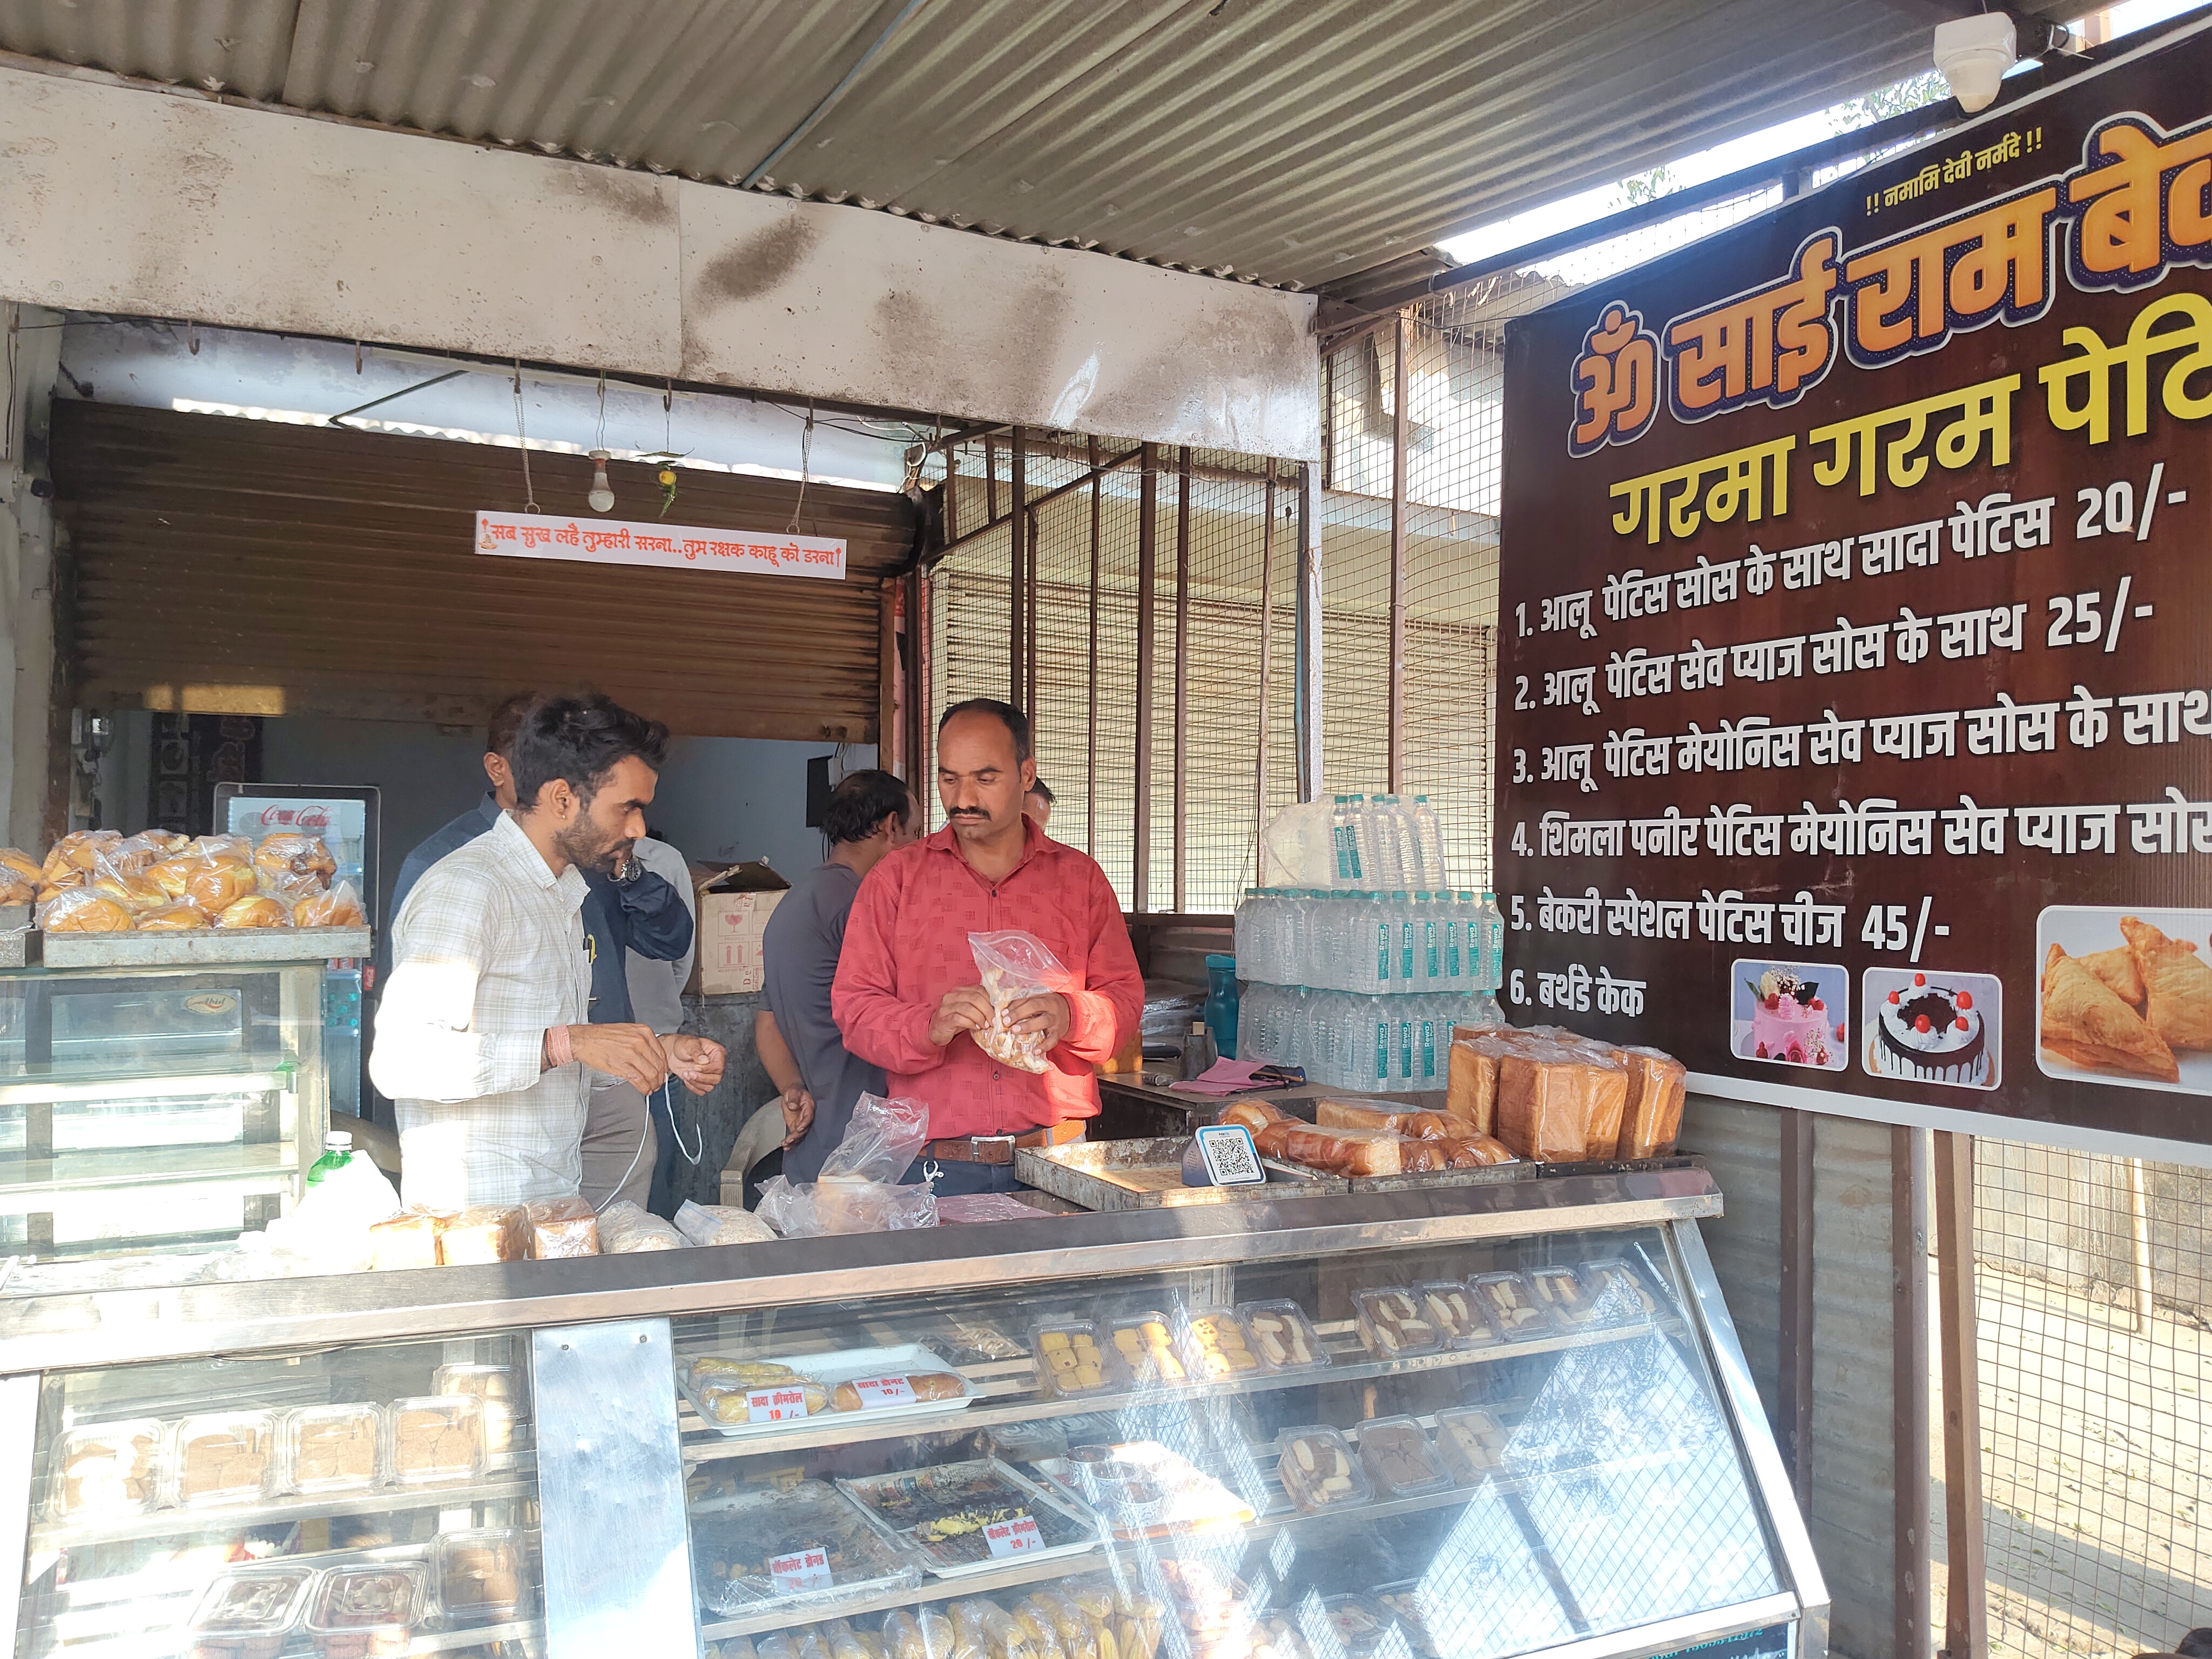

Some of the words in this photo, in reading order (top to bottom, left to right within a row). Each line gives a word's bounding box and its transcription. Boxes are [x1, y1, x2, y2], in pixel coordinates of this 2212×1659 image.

[1884, 164, 1940, 207] नमामि
[1942, 150, 1973, 184] देवी
[1974, 131, 2022, 171] नर्मदे
[1576, 309, 1654, 445] ॐ
[1671, 237, 1837, 409] साई
[1846, 186, 2056, 353] राम
[1609, 434, 1796, 545] गरमा
[1810, 374, 2020, 497] गरम
[490, 524, 517, 540] सब
[520, 526, 551, 548] सुख
[554, 522, 579, 546] लहै
[582, 528, 631, 552] तुम्हारी
[682, 539, 707, 561] तुम
[709, 541, 745, 557] रक्षक
[748, 545, 780, 568] काहू
[802, 549, 835, 565] डरना
[1515, 603, 1533, 637] 1.
[1541, 590, 1597, 639] आलू
[1602, 569, 1671, 621] पेटिस
[1675, 556, 1741, 609] सोस
[1744, 544, 1777, 595] के
[1781, 537, 1854, 590] साथ
[1859, 520, 1943, 576] सादा
[1948, 493, 2055, 559] पेटिस
[2076, 462, 2187, 541] 20/-
[1515, 676, 1536, 711] 2.
[1543, 666, 1601, 716] आलू
[1605, 648, 1675, 698] पेटिस
[1678, 639, 1727, 690] सेव
[1730, 636, 1806, 682] प्याज
[1810, 617, 1889, 670] सोस
[1893, 607, 1932, 664] के
[1937, 604, 2027, 659] साथ
[2048, 575, 2154, 652] 25/-
[1513, 748, 1534, 784] 3.
[1541, 743, 1599, 792] आलू
[1603, 727, 1673, 777] पेटिस
[1676, 717, 1803, 773] मेयोनिस
[1808, 709, 1865, 762] सेव
[1869, 711, 1959, 759] प्याज
[1964, 692, 2060, 756] सोस
[2065, 685, 2113, 747] के
[1511, 821, 1534, 857] 4.
[1539, 811, 1627, 857] शिमला
[1629, 806, 1701, 857] पनीर
[1704, 804, 1784, 856] पेटिस
[1788, 798, 1936, 855] मेयोनिस
[1940, 794, 2009, 854] सेव
[2014, 805, 2121, 854] प्याज
[1510, 895, 1532, 932] 5.
[1537, 886, 1602, 935] बेकरी
[1605, 888, 1692, 940] स्पेशल
[1696, 889, 1775, 945] पेटिस
[1779, 891, 1846, 948] चीज
[1861, 895, 1950, 963] 45/-
[1510, 969, 1532, 1006] 6.
[1537, 963, 1593, 1012] बर्थडे
[1595, 966, 1647, 1017] केक
[751, 1396, 768, 1407] सादा
